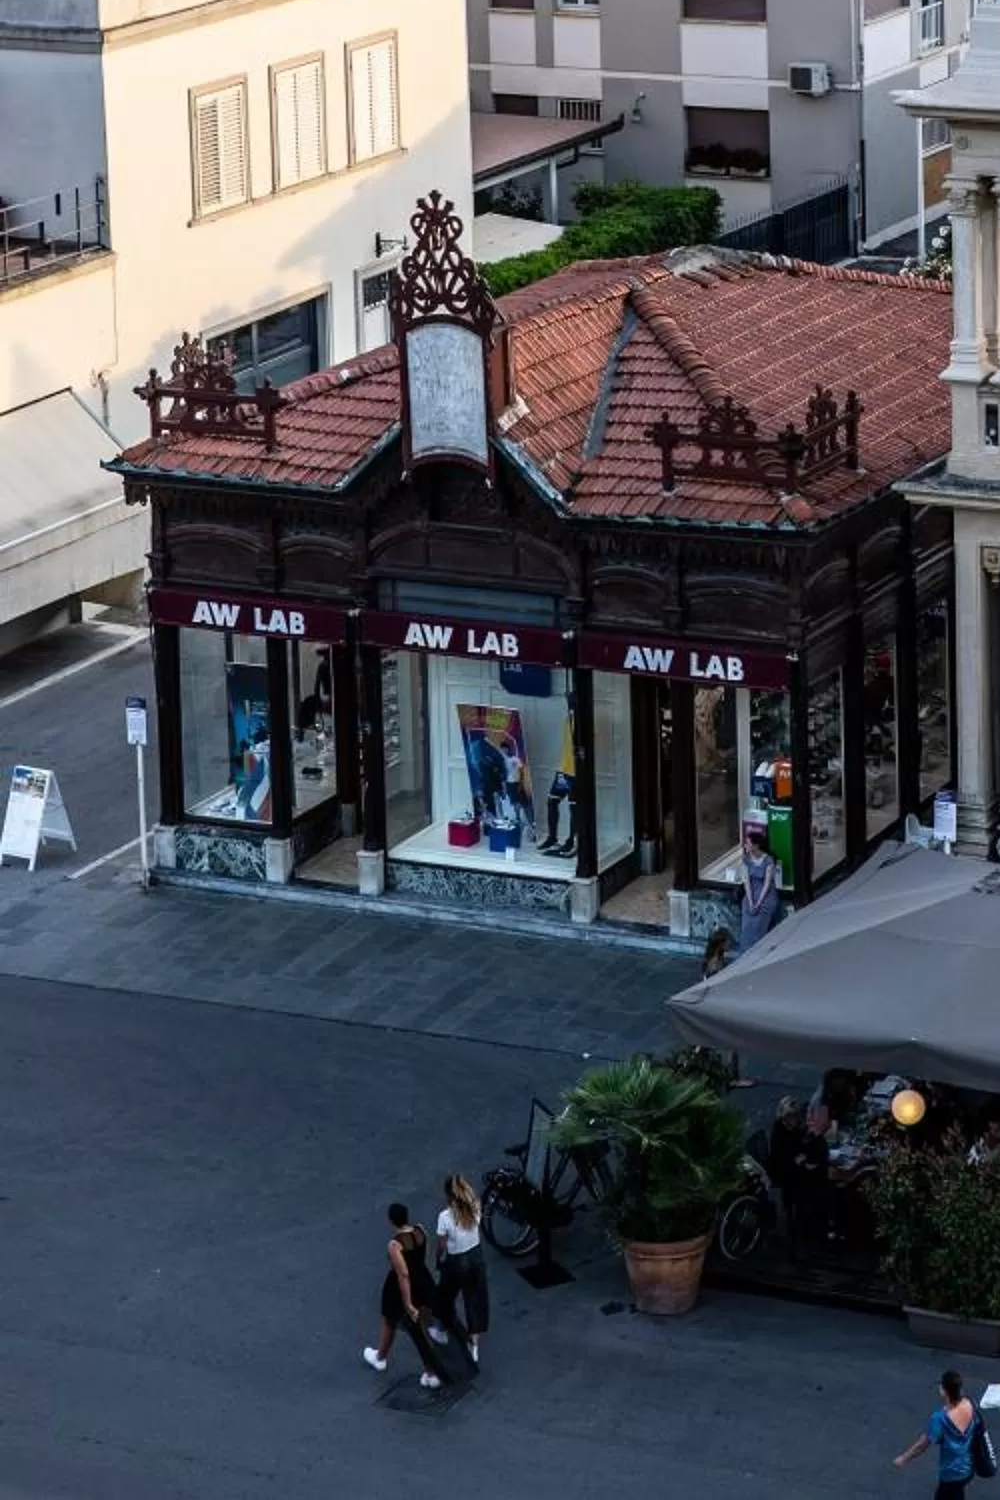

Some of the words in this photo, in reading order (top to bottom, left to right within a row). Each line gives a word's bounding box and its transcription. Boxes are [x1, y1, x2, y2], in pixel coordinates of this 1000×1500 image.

[192, 601, 240, 627] AW
[254, 607, 305, 635] LAB
[404, 622, 454, 649] AW
[467, 629, 519, 657] LAB
[623, 645, 675, 671] AW
[690, 652, 745, 681] LAB
